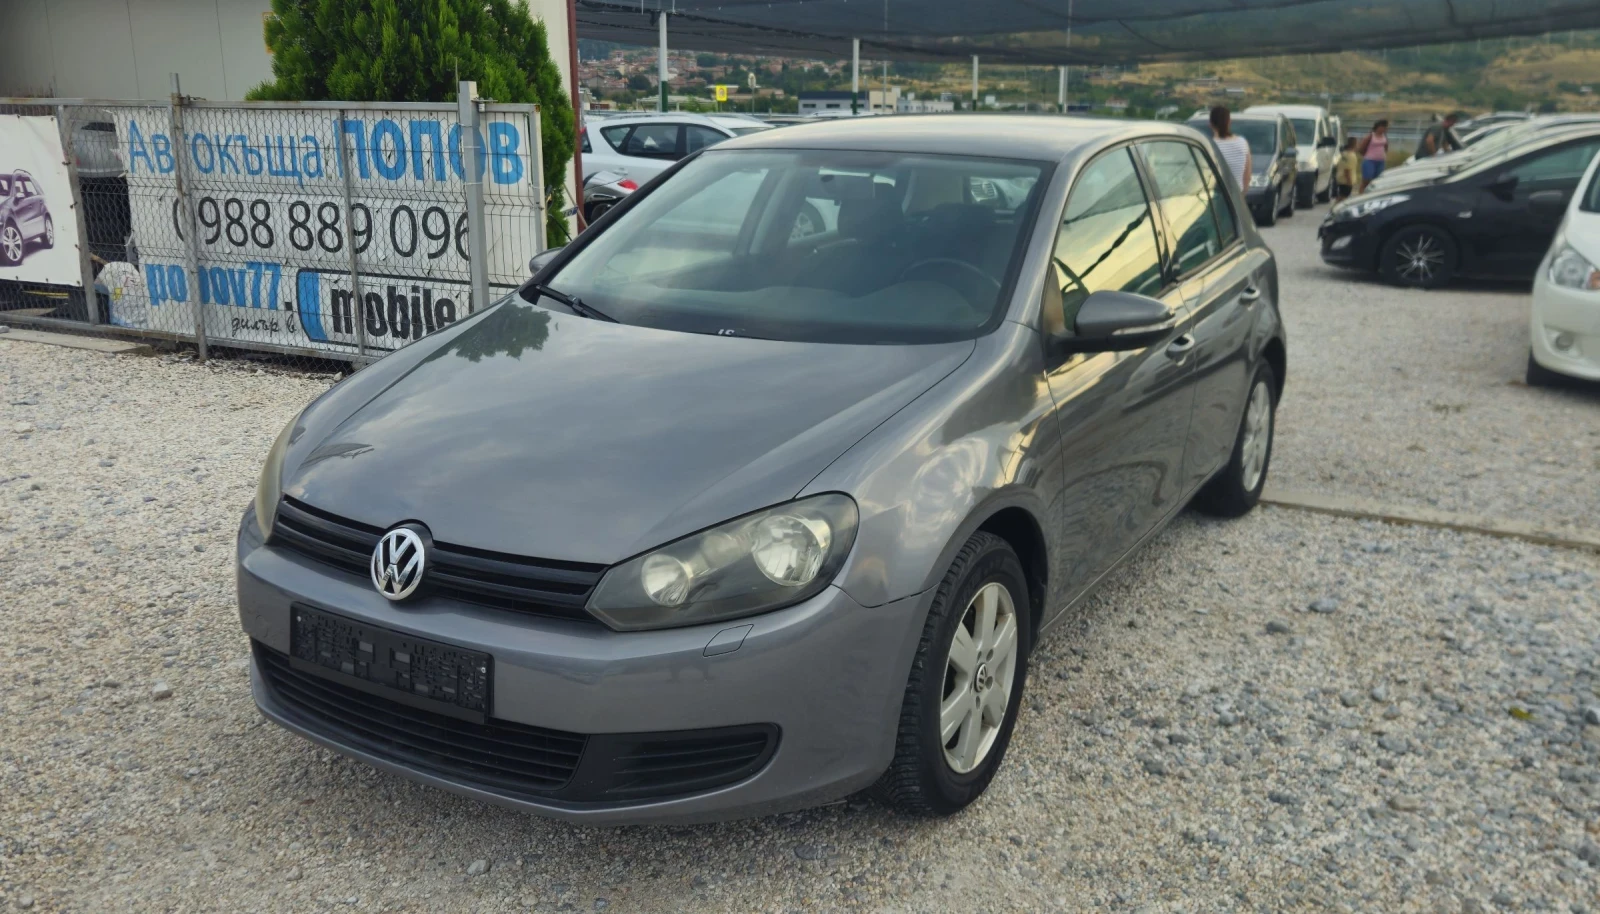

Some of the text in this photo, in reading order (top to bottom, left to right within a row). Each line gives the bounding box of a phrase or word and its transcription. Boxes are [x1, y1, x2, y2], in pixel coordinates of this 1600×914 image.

[129, 119, 524, 189] Авокъща ПОПОВ
[288, 200, 373, 255] 889
